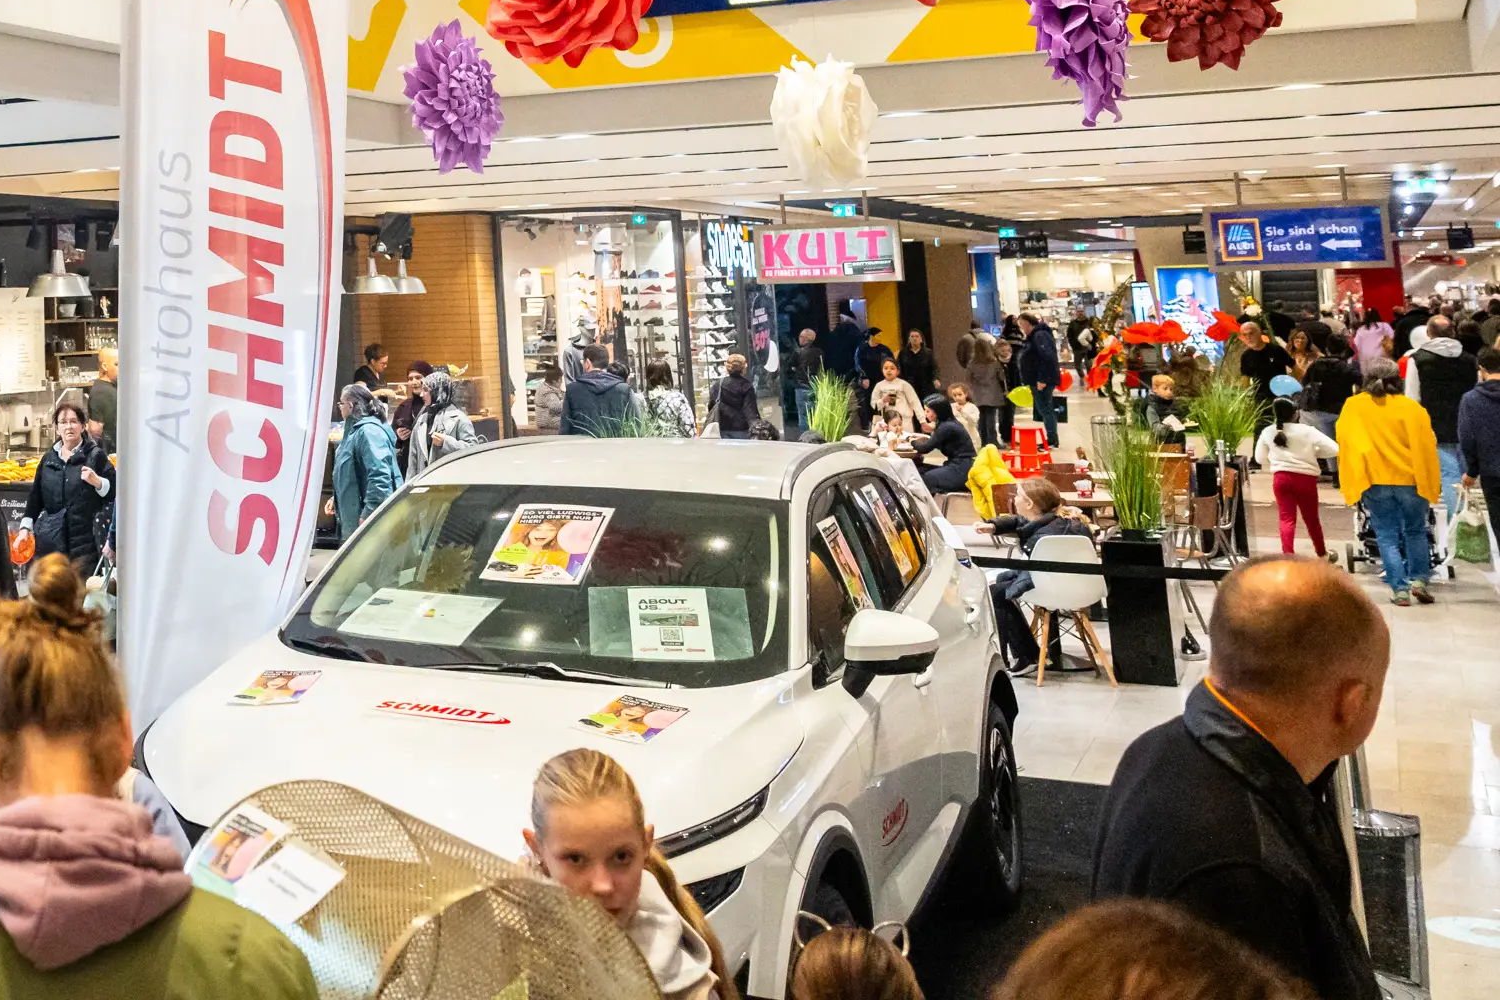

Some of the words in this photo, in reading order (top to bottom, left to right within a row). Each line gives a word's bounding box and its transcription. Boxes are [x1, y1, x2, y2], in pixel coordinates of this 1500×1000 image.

[1265, 226, 1284, 237] Sie
[1288, 224, 1315, 236] sind
[1318, 223, 1358, 235] schon
[763, 230, 888, 268] KULT
[1228, 242, 1255, 251] ALDI
[1266, 241, 1292, 252] fast
[1295, 240, 1312, 251] da
[143, 149, 193, 455] Autohaus
[207, 29, 284, 566] SCHMIDT
[376, 700, 496, 720] SCHMIDT
